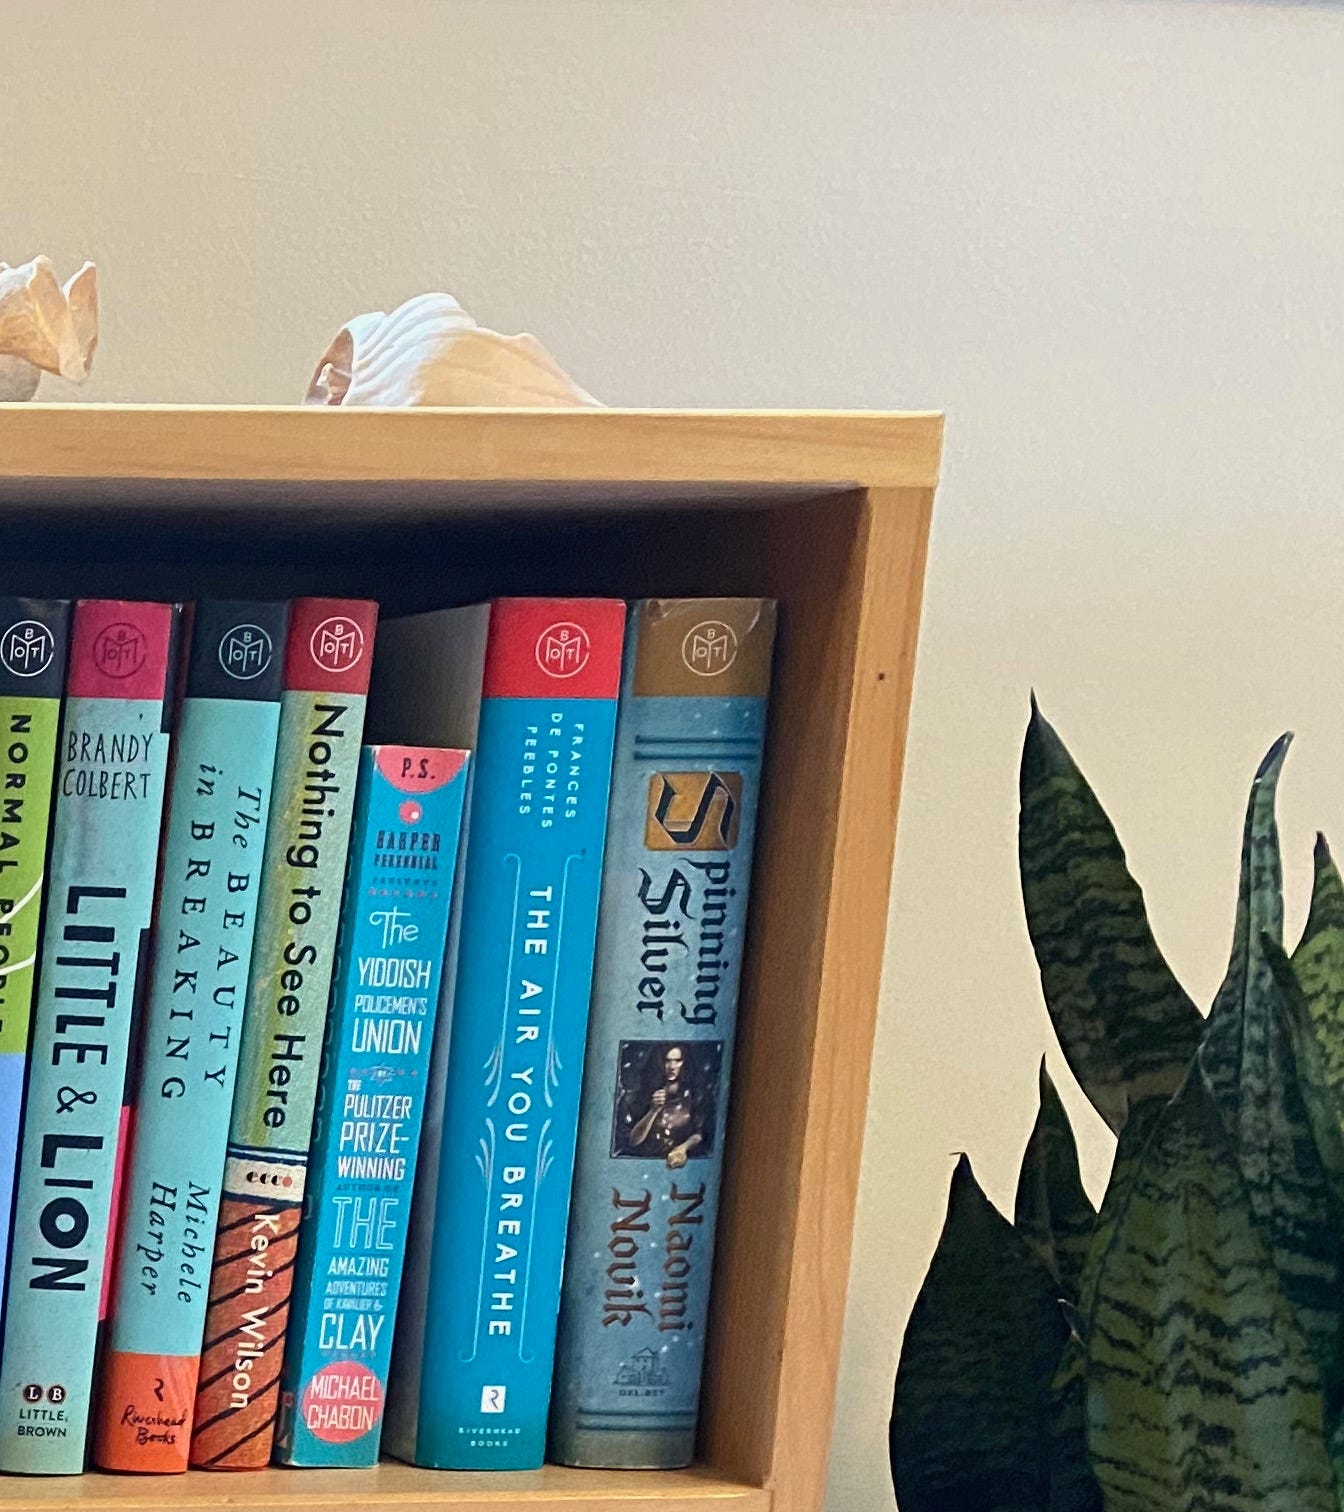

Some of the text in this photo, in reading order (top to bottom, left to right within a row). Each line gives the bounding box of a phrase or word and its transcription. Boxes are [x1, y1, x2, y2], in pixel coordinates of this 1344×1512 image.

[541, 712, 563, 829] DE PONTES
[564, 723, 585, 820] FRANCES
[374, 854, 438, 870] PERENNIAL
[637, 867, 691, 1022] Silver
[488, 887, 552, 1336] THE AIR YOU BREATHE
[230, 1214, 280, 1409] Kevin Wilson
[325, 1281, 387, 1297] ADVENTURES
[17, 1425, 67, 1437] BROWN
